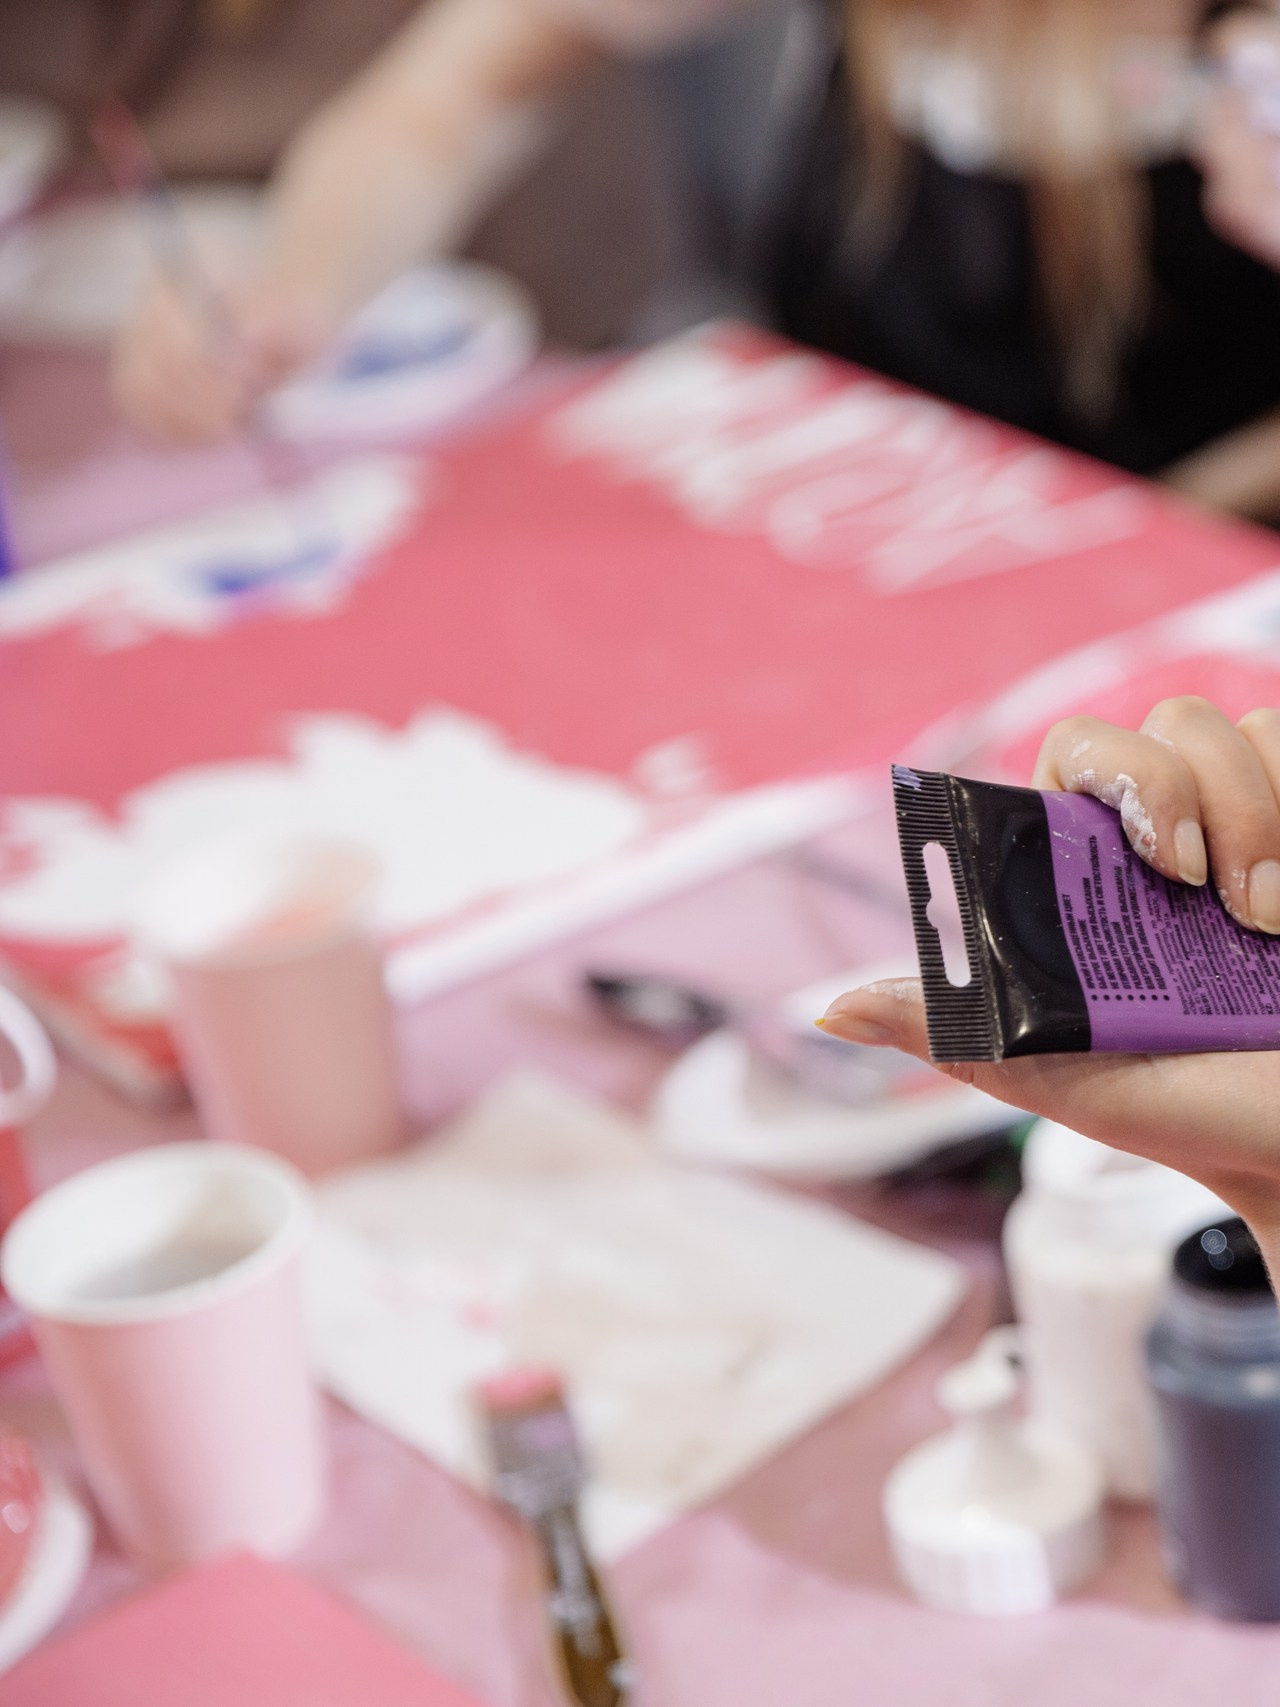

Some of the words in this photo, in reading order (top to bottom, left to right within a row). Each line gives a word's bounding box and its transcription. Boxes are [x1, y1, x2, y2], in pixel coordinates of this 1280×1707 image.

[1062, 894, 1074, 913] ЦВЕТ
[1083, 877, 1098, 924] ВЫСЫХАНИИ
[1077, 918, 1098, 961] ВЫСЫХАНИЕ
[1090, 925, 1102, 939] ПРИ
[1095, 940, 1108, 956] ЦВЕТ
[1091, 961, 1108, 990] БЫСТРОЕ
[1110, 981, 1120, 990] НЕ
